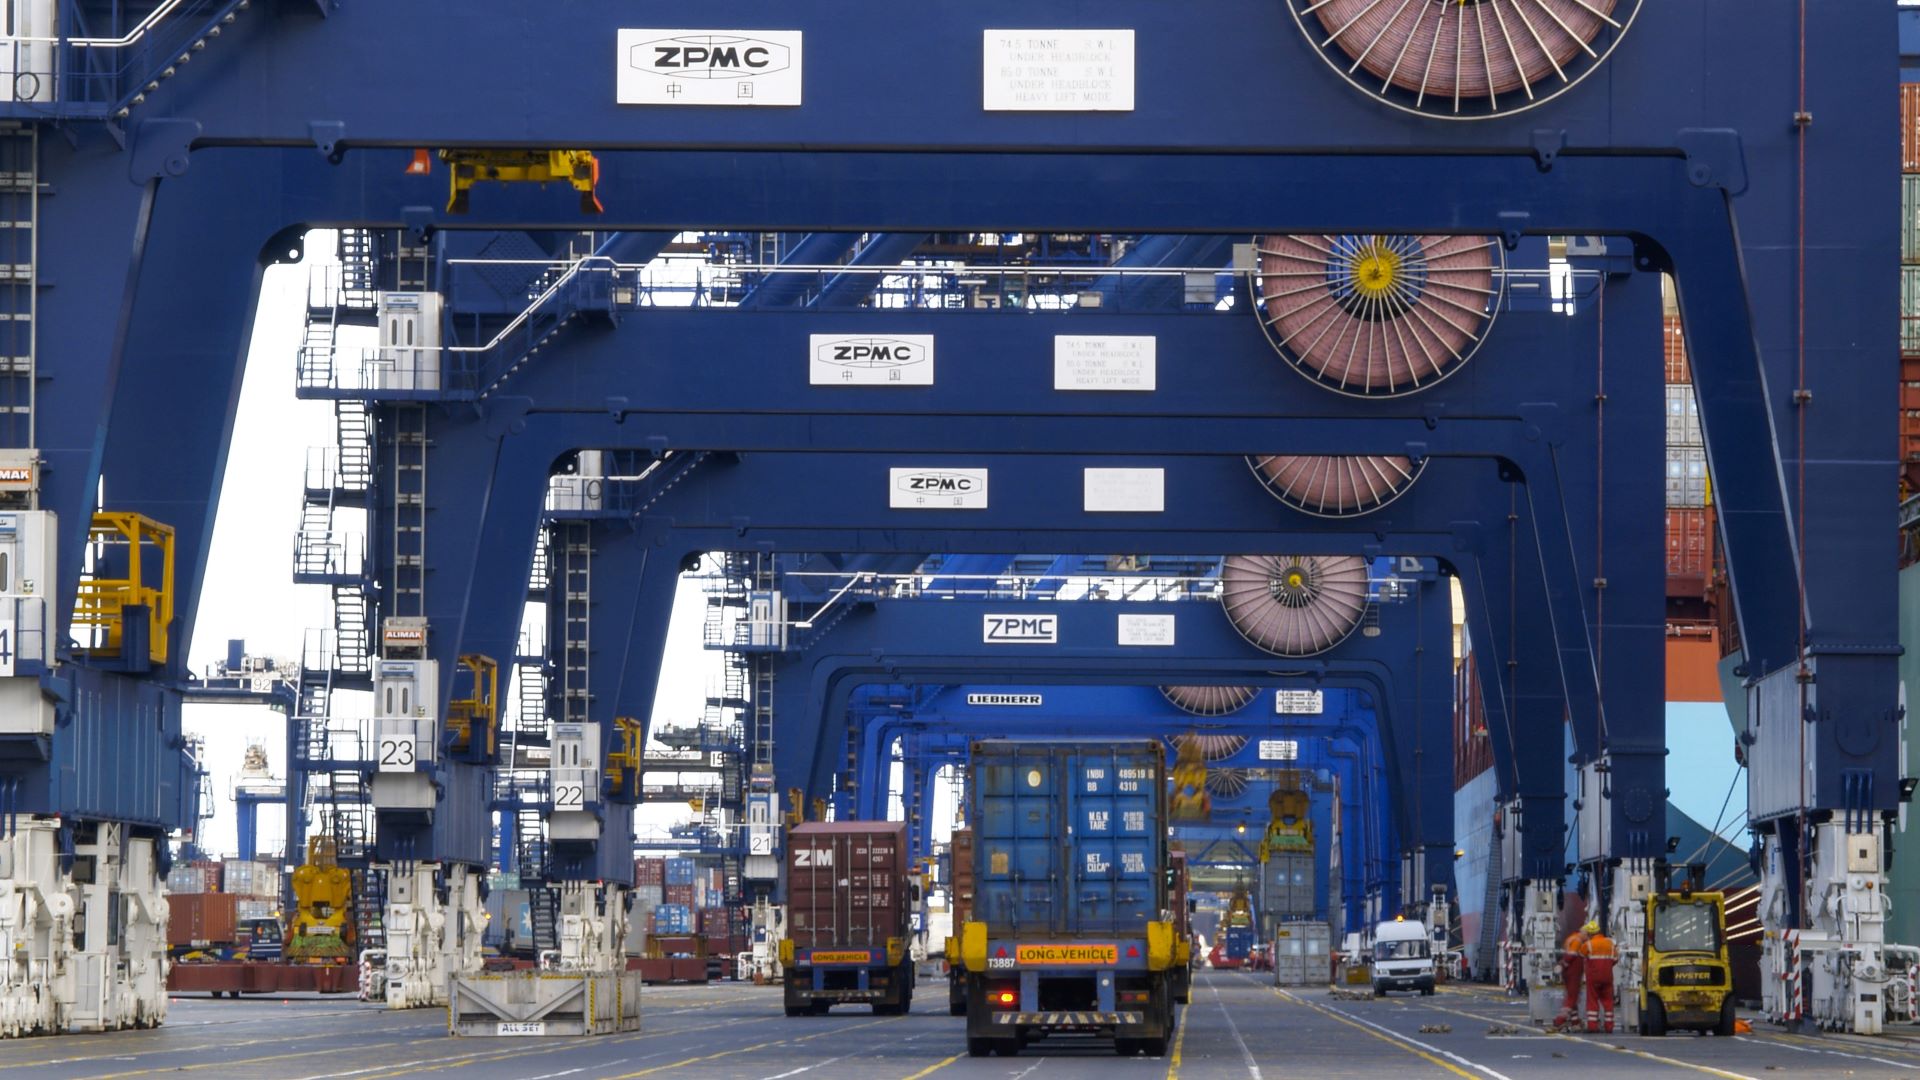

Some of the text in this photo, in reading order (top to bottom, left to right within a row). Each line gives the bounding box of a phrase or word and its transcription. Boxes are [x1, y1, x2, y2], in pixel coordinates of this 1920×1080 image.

[654, 46, 769, 68] ZPMC
[833, 346, 911, 361] ZPMC
[910, 478, 971, 490] ZPMC
[988, 619, 1052, 639] ZPMC
[969, 695, 1040, 704] LIEBHERR
[380, 740, 414, 765] 23
[1119, 781, 1137, 791] 4310
[556, 786, 582, 805] 22
[1090, 820, 1107, 830] TARE
[752, 837, 770, 851] 21
[794, 849, 833, 866] ZIM
[1087, 853, 1100, 863] NET
[1020, 949, 1114, 960] LONG VEHICLE
[988, 958, 1016, 968] T3887
[502, 1023, 520, 1032] ALL
